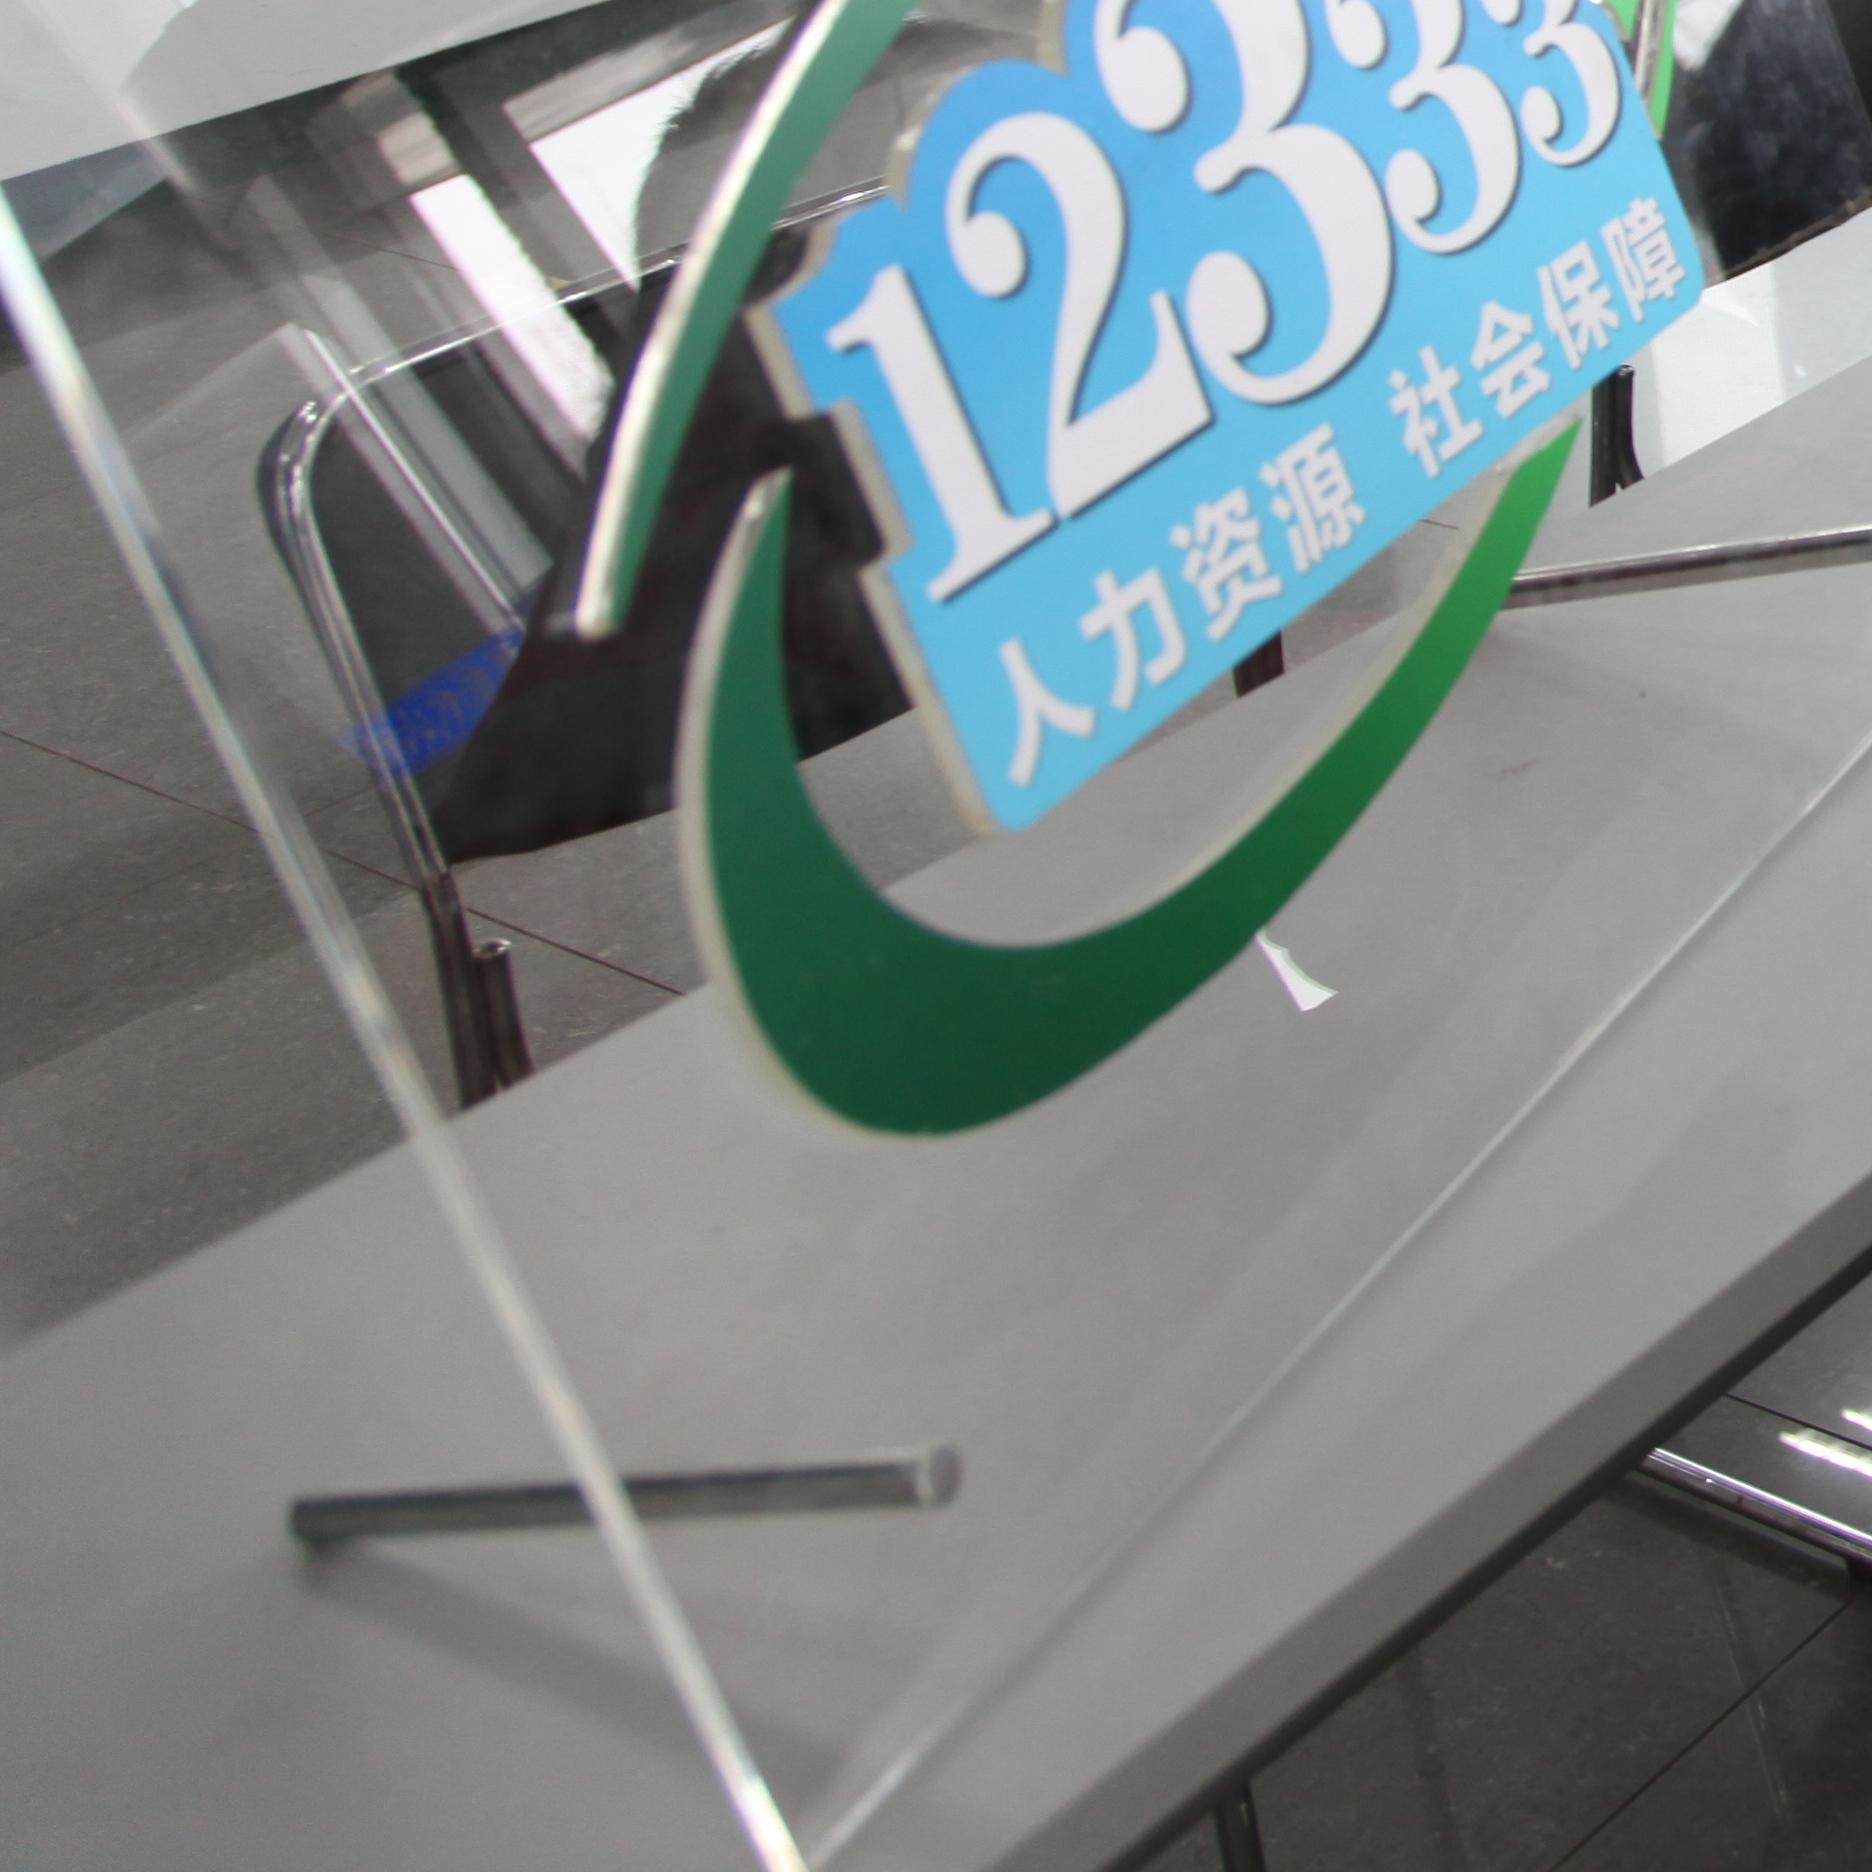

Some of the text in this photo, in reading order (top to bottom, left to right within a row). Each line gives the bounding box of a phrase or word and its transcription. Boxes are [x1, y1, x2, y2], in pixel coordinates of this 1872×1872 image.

[998, 196, 1688, 788] 人力资源 社会保障
